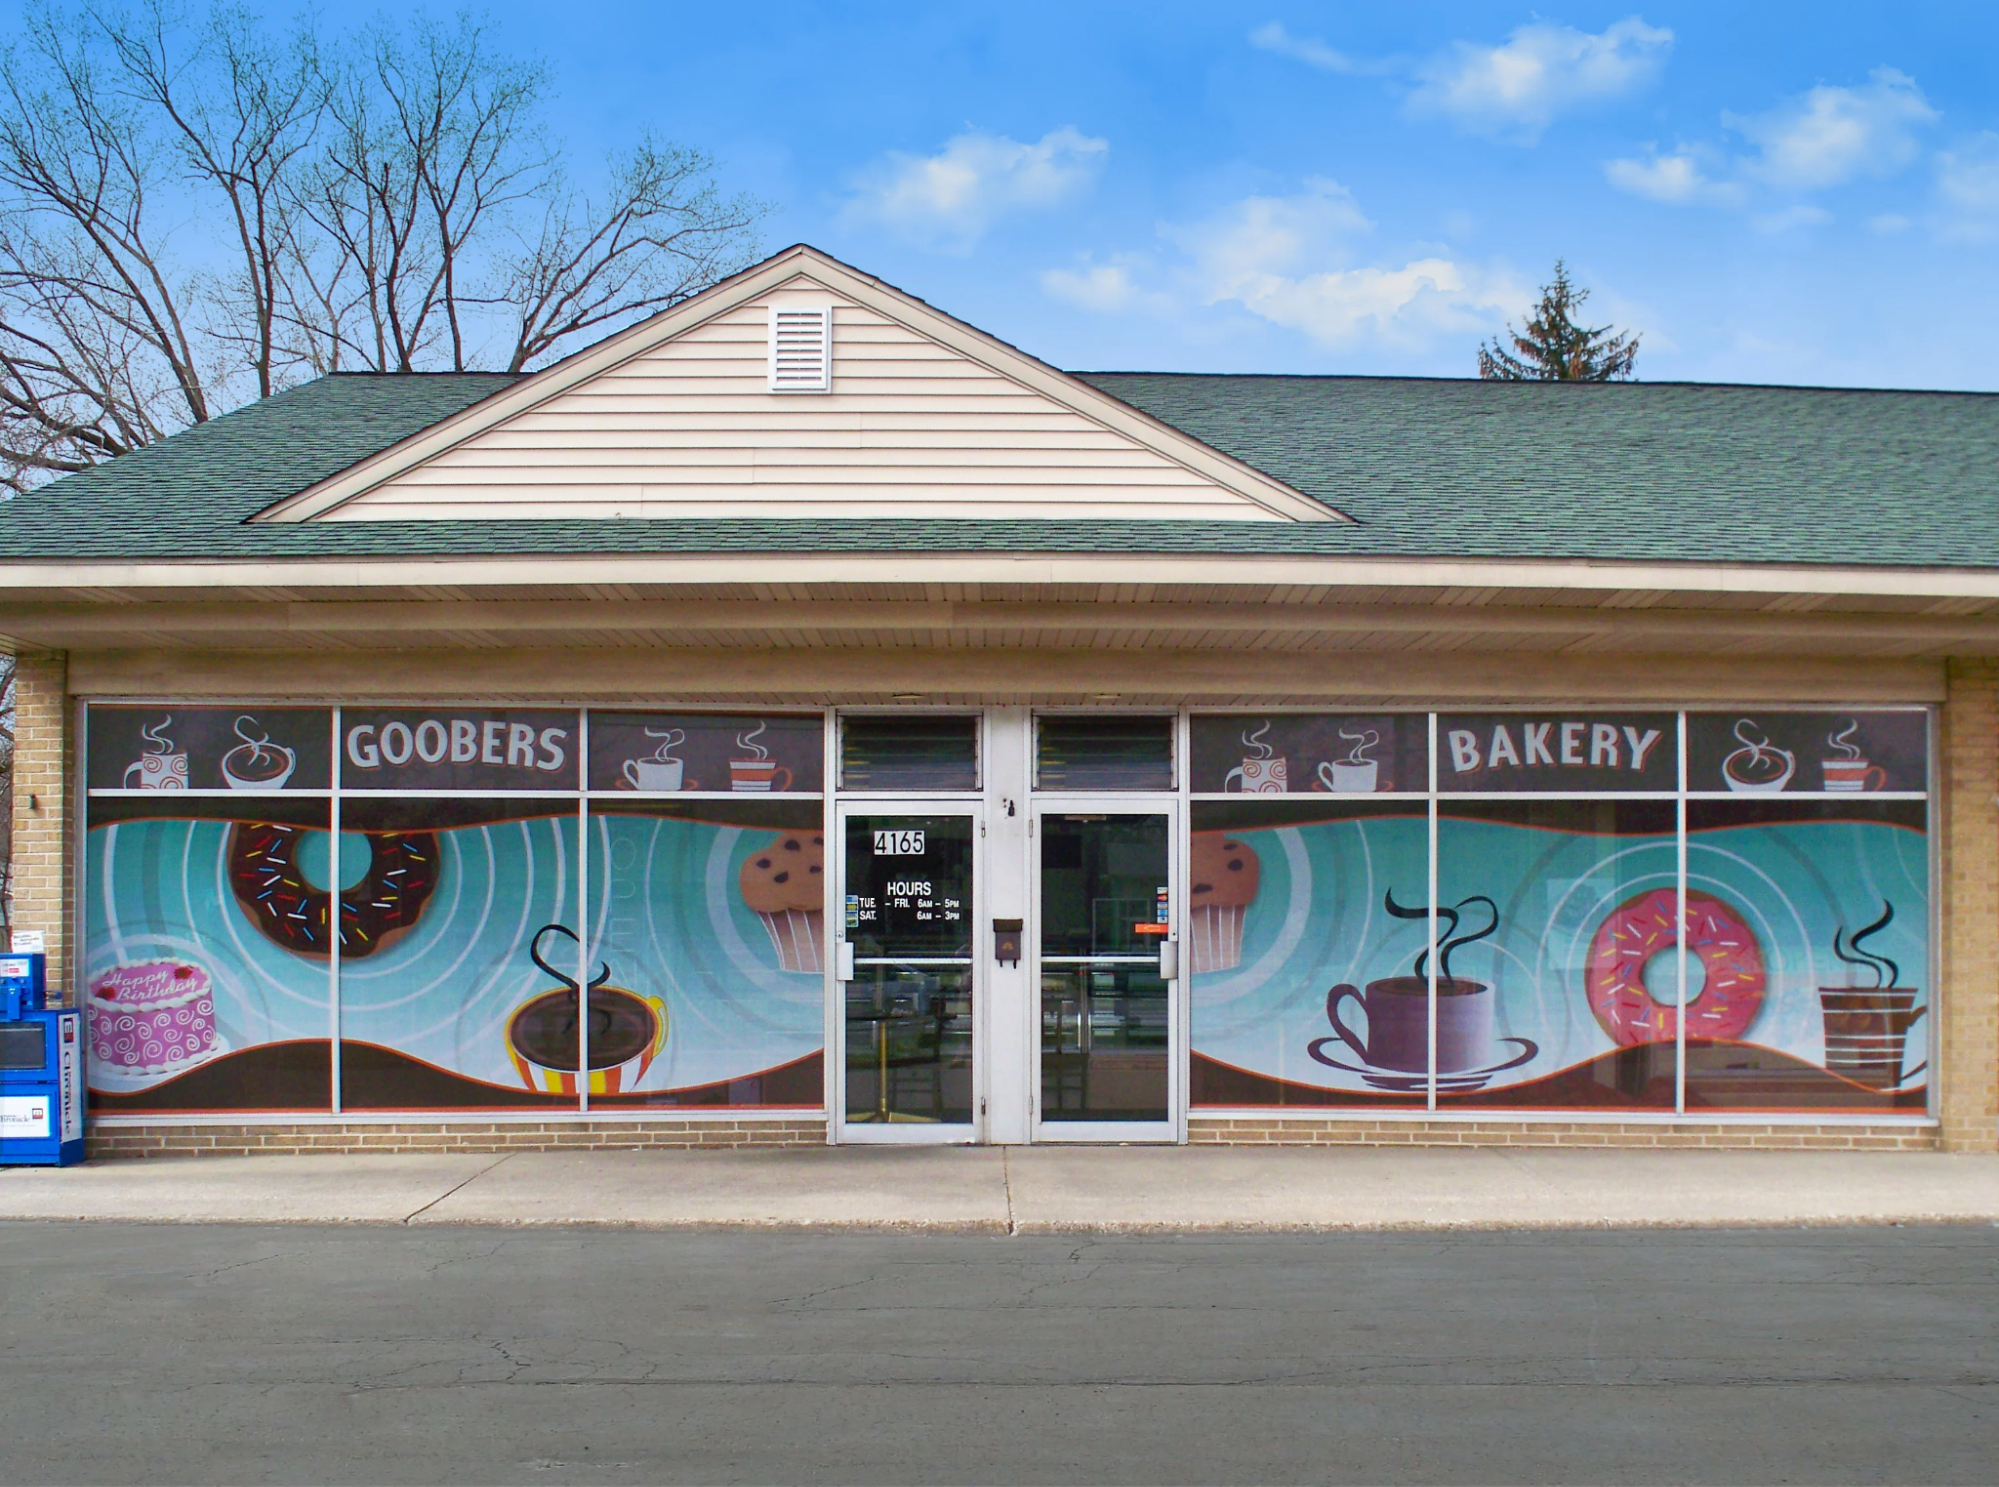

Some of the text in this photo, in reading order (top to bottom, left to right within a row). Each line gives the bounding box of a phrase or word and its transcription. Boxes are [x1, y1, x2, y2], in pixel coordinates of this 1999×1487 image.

[347, 719, 568, 771] GOOBERS
[1448, 722, 1662, 773] BAKERY
[875, 831, 923, 854] 4165
[887, 882, 931, 896] HOURS
[859, 897, 876, 908] TUE.
[894, 898, 910, 908] FRI.
[859, 911, 877, 920] SAT.
[102, 971, 168, 989] Happy
[116, 978, 197, 1000] Birthday
[64, 1051, 72, 1134] Chronicle
